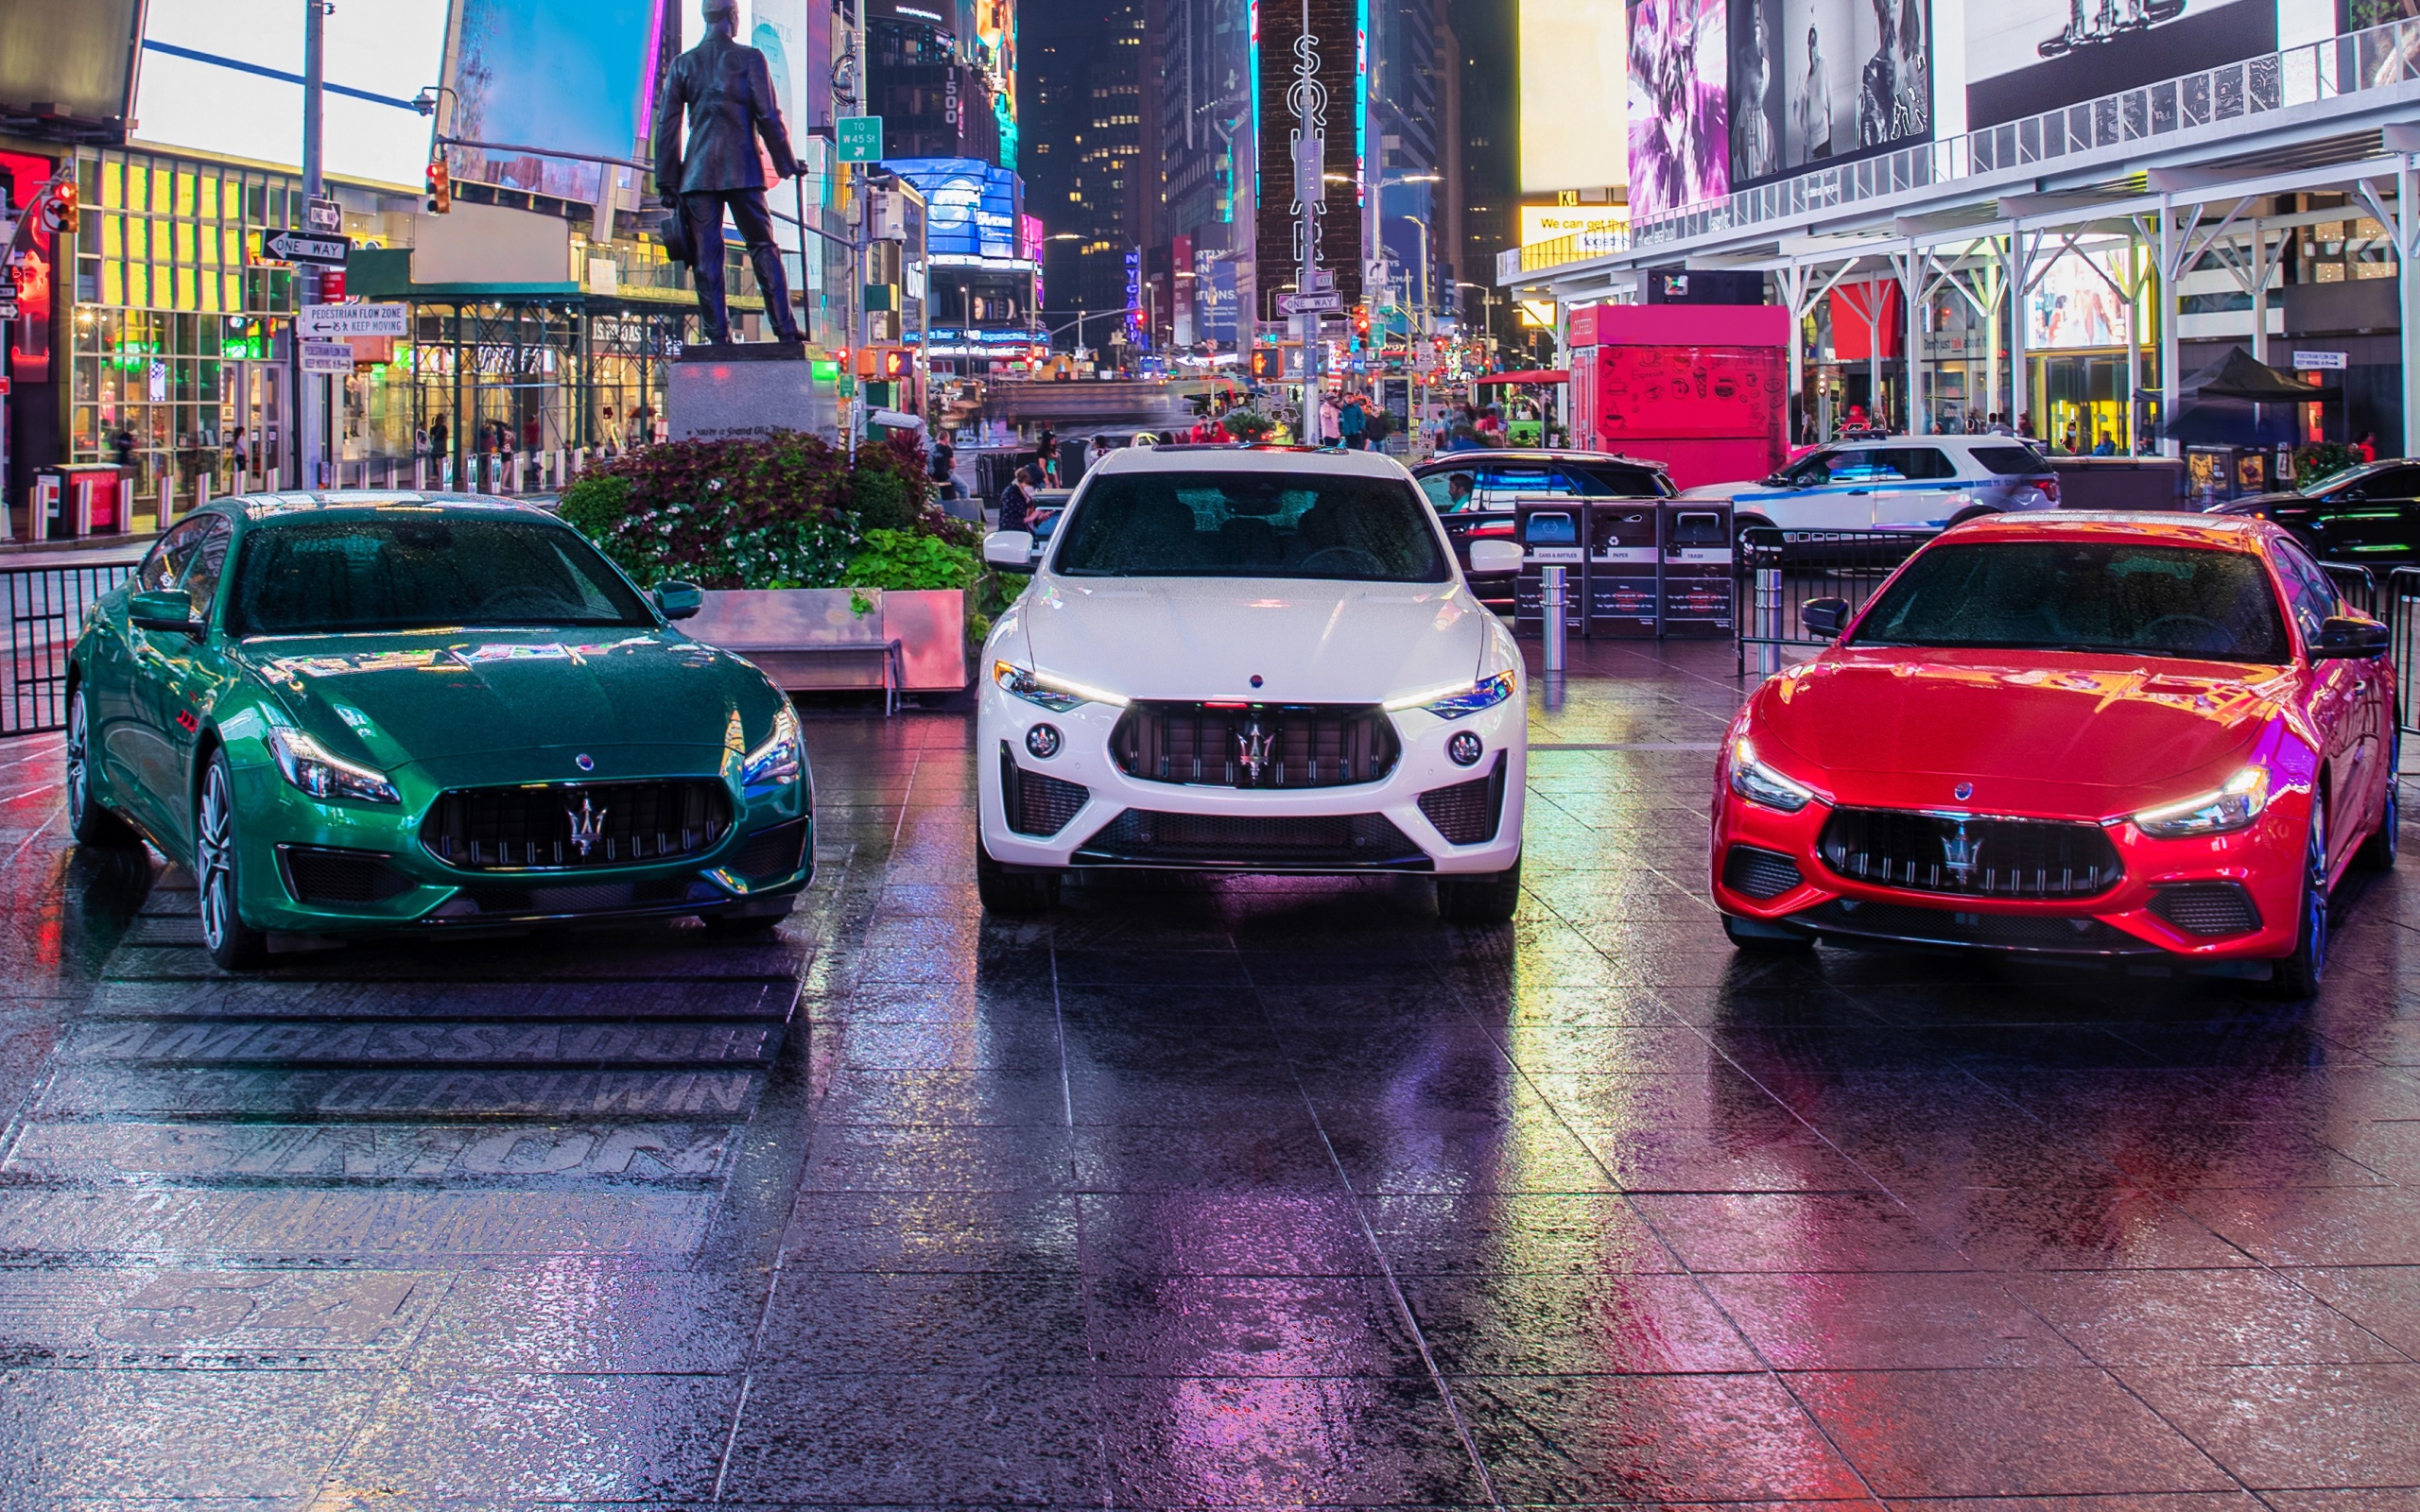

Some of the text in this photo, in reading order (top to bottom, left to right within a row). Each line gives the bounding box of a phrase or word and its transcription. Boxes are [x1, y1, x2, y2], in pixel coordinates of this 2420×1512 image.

[945, 67, 957, 124] 1500
[854, 122, 865, 131] TO
[843, 134, 875, 144] W 45 St
[313, 210, 323, 222] ONE
[1541, 218, 1560, 229] We
[1563, 219, 1583, 229] can
[1587, 219, 1605, 232] get
[276, 238, 339, 256] ONE WAY
[1288, 298, 1334, 309] ONE WAY
[311, 307, 402, 319] PEDESTRIAN FLOW ZONE
[352, 321, 402, 331] KEEP MOVING
[304, 346, 331, 356] PEDESTRIAN
[1419, 353, 1433, 362] 25
[76, 1024, 769, 1058] AMBASSADOR
